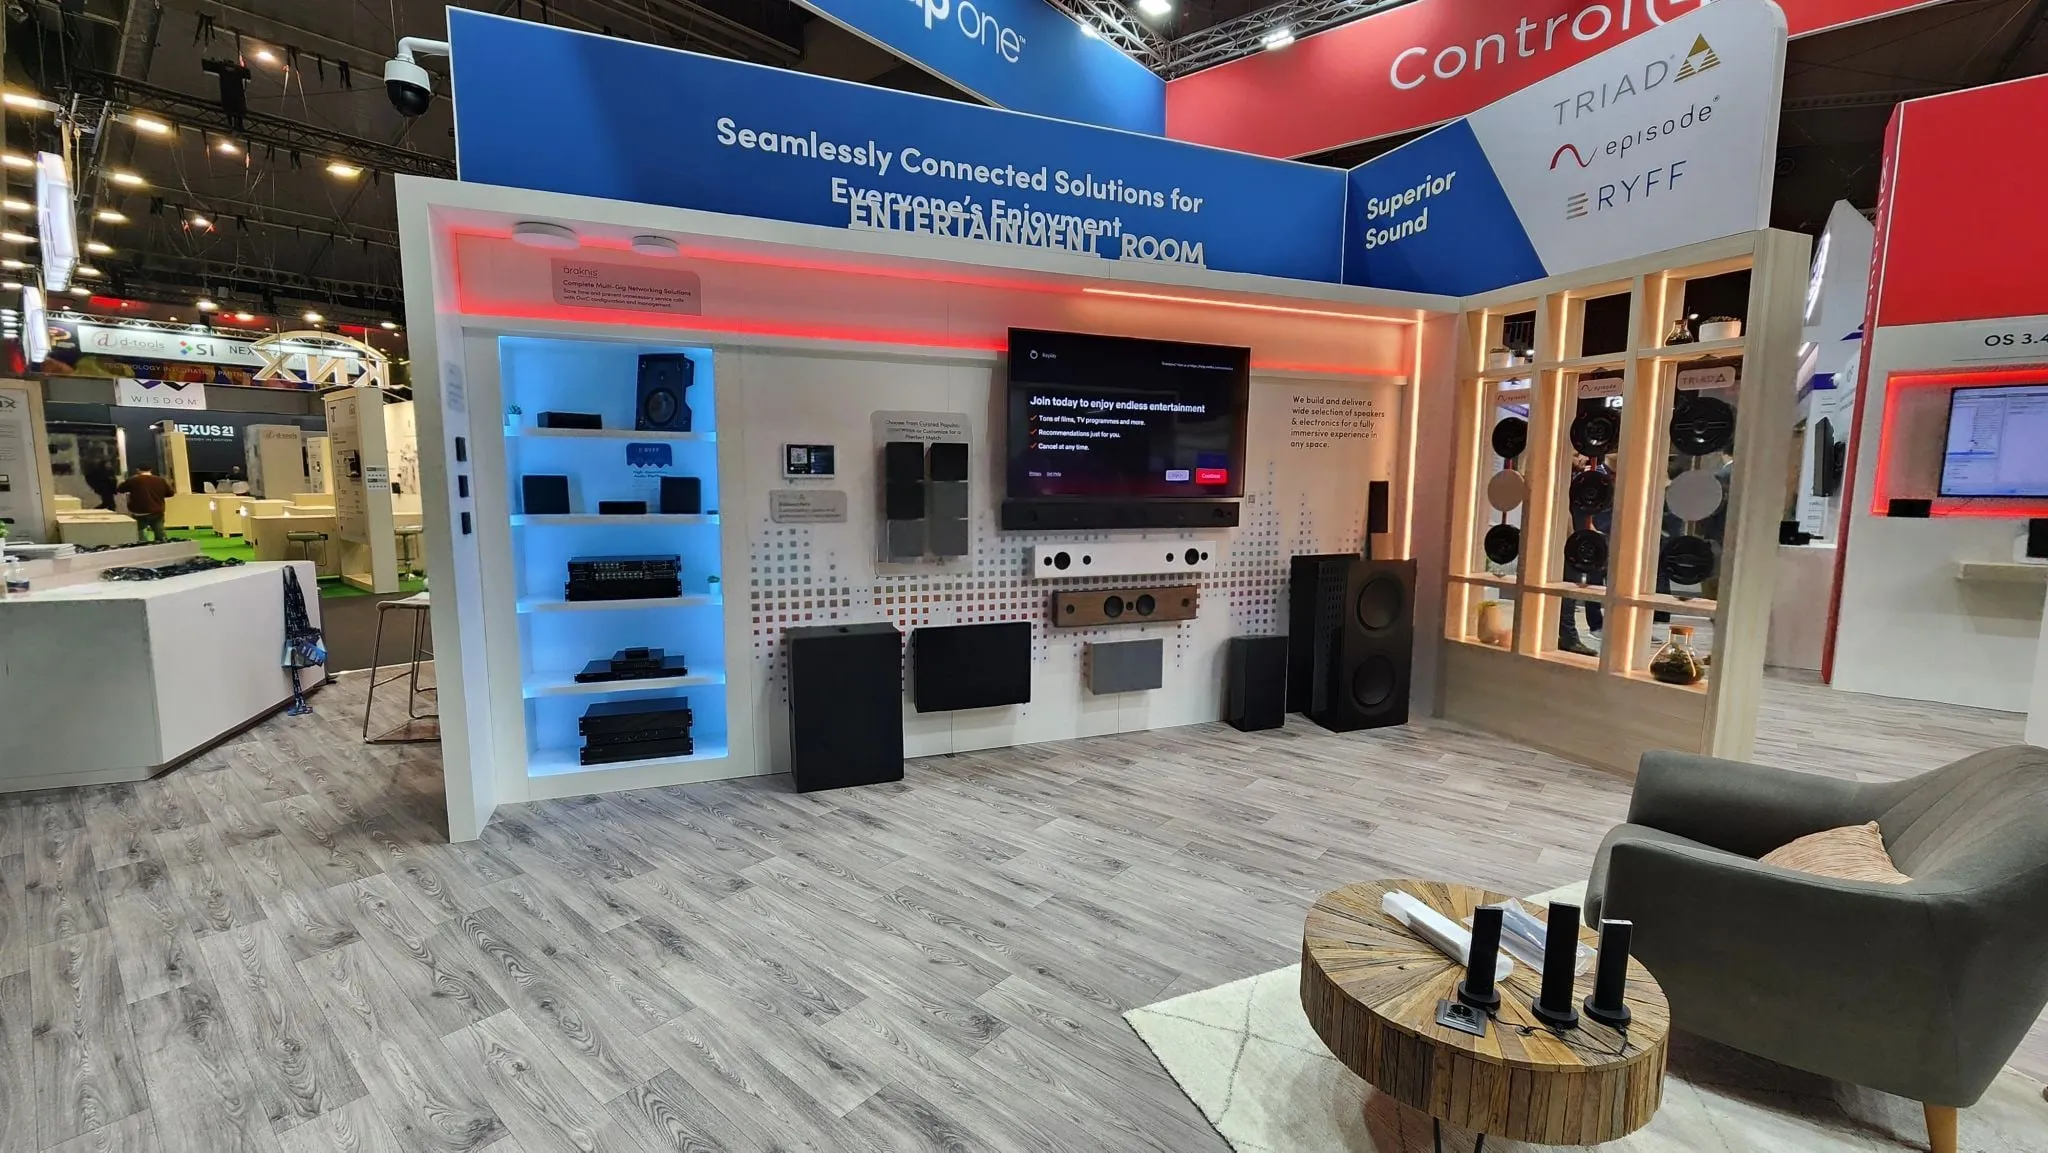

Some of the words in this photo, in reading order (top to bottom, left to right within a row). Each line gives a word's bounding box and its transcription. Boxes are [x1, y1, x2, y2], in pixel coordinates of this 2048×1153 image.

[716, 117, 892, 176] Seamlessly
[900, 147, 1047, 192] Connected
[1054, 169, 1164, 208] Solutions
[1170, 188, 1203, 213] for
[1597, 160, 1687, 211] RYFF
[1367, 171, 1456, 220] Superior
[991, 198, 1122, 239] Enjoyment
[849, 199, 1099, 255] ENTERTAINMENT
[1120, 233, 1206, 267] ROOM
[1366, 207, 1428, 249] Sound
[563, 280, 594, 288] Complete
[628, 286, 662, 295] Networking
[664, 288, 691, 297] Solutions
[1984, 333, 2015, 347] OS
[196, 344, 214, 356] SI
[104, 362, 160, 371] TECHNOLOGY
[164, 366, 215, 376] INTEGRATION
[131, 395, 197, 406] WISDOM
[1030, 396, 1051, 406] Join
[1052, 397, 1078, 409] today
[1079, 398, 1089, 408] to
[1090, 399, 1114, 411] enjoy
[1116, 400, 1148, 410] endless
[1149, 402, 1205, 413] entertainment
[1293, 395, 1304, 403] We
[1306, 395, 1325, 404] build
[1326, 397, 1340, 405] and
[1342, 398, 1365, 406] deliver
[1605, 395, 1623, 408] ra
[1292, 407, 1309, 415] wide
[1311, 408, 1343, 416] selection
[1344, 409, 1352, 417] of
[1354, 410, 1385, 418] speakers
[1291, 417, 1297, 425] &
[1299, 418, 1340, 427] electronics
[1341, 419, 1352, 427] for
[1360, 420, 1375, 430] fully
[1038, 429, 1089, 437] Recommendations
[1090, 430, 1100, 439] just
[1290, 429, 1329, 437] immersive
[1330, 431, 1369, 440] experience
[1290, 441, 1304, 449] any
[1306, 441, 1330, 449] space.
